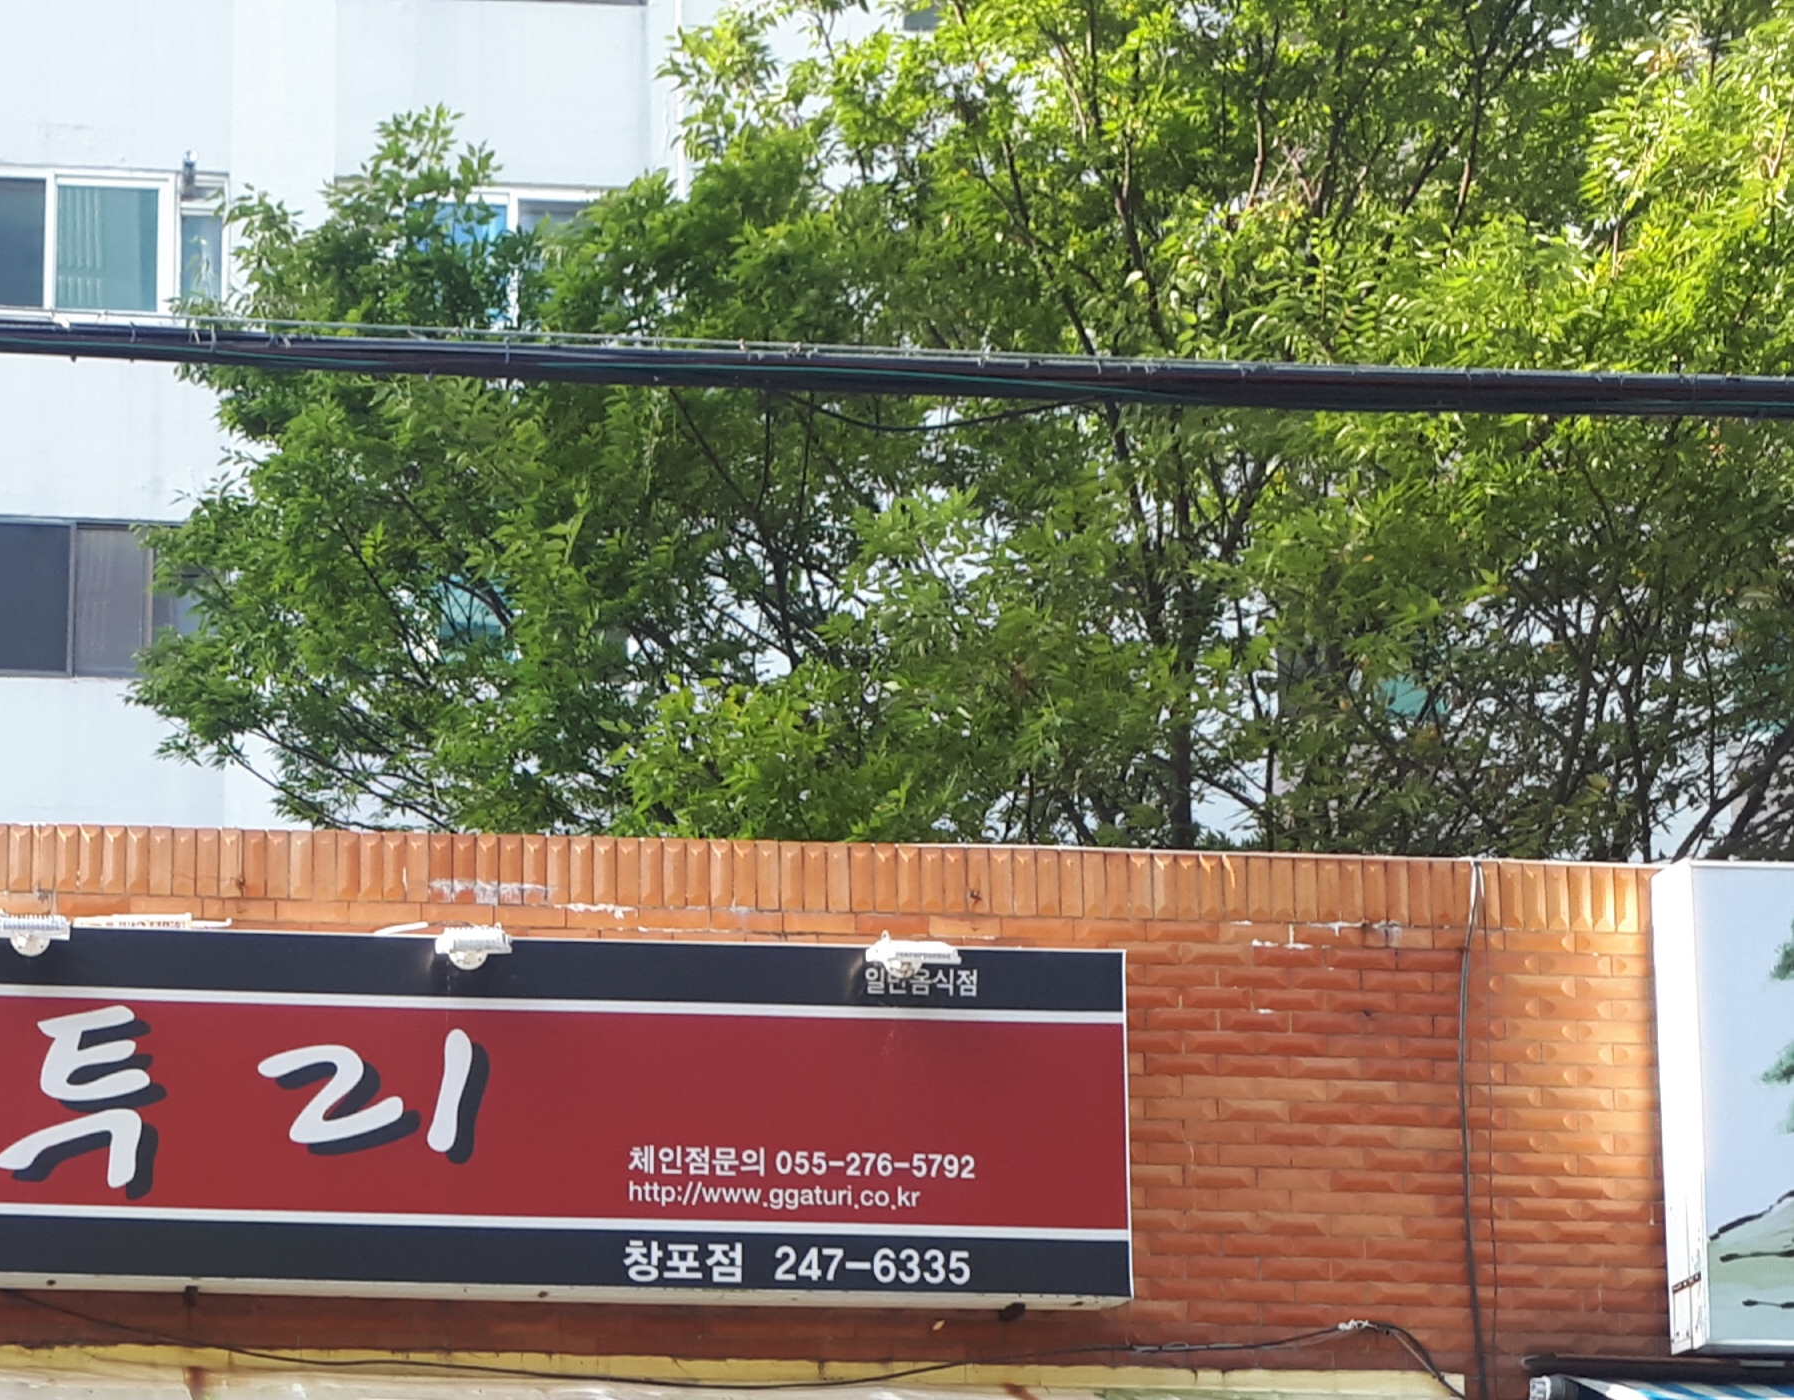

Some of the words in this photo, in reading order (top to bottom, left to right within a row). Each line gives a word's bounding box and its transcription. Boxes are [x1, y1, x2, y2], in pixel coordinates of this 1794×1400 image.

[627, 1144, 766, 1178] 체인점문의
[775, 1150, 976, 1179] 055-276-5792
[627, 1180, 921, 1210] http://www.ggaturi.co.kr
[622, 1238, 744, 1284] 창포점
[773, 1245, 971, 1285] 247-6335
